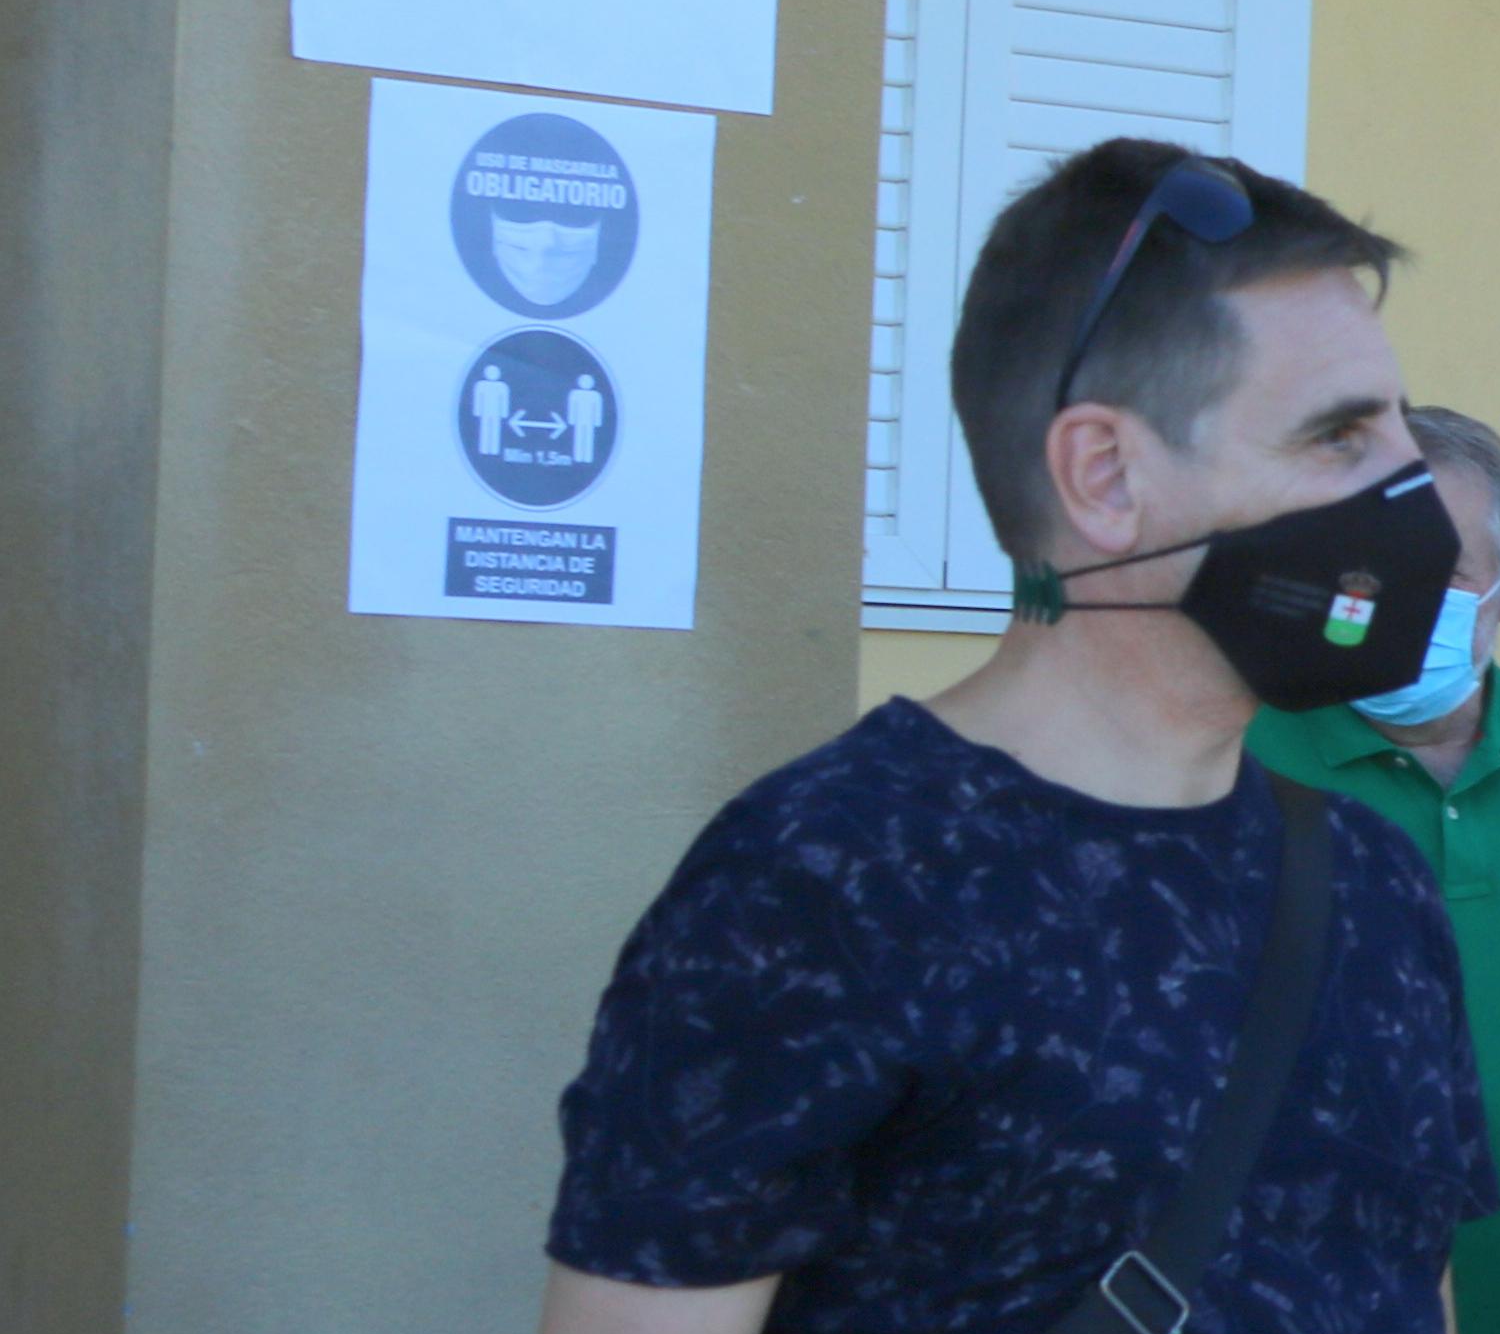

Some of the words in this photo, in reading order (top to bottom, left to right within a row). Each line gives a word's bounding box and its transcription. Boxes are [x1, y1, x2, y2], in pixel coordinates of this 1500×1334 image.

[467, 170, 627, 209] OBLIGATORIO
[455, 526, 576, 548] MANTENGAN
[581, 534, 606, 550] LA
[465, 550, 566, 572] DISTANCIA
[569, 556, 595, 573] DE
[474, 575, 586, 597] SEGURIDAD
